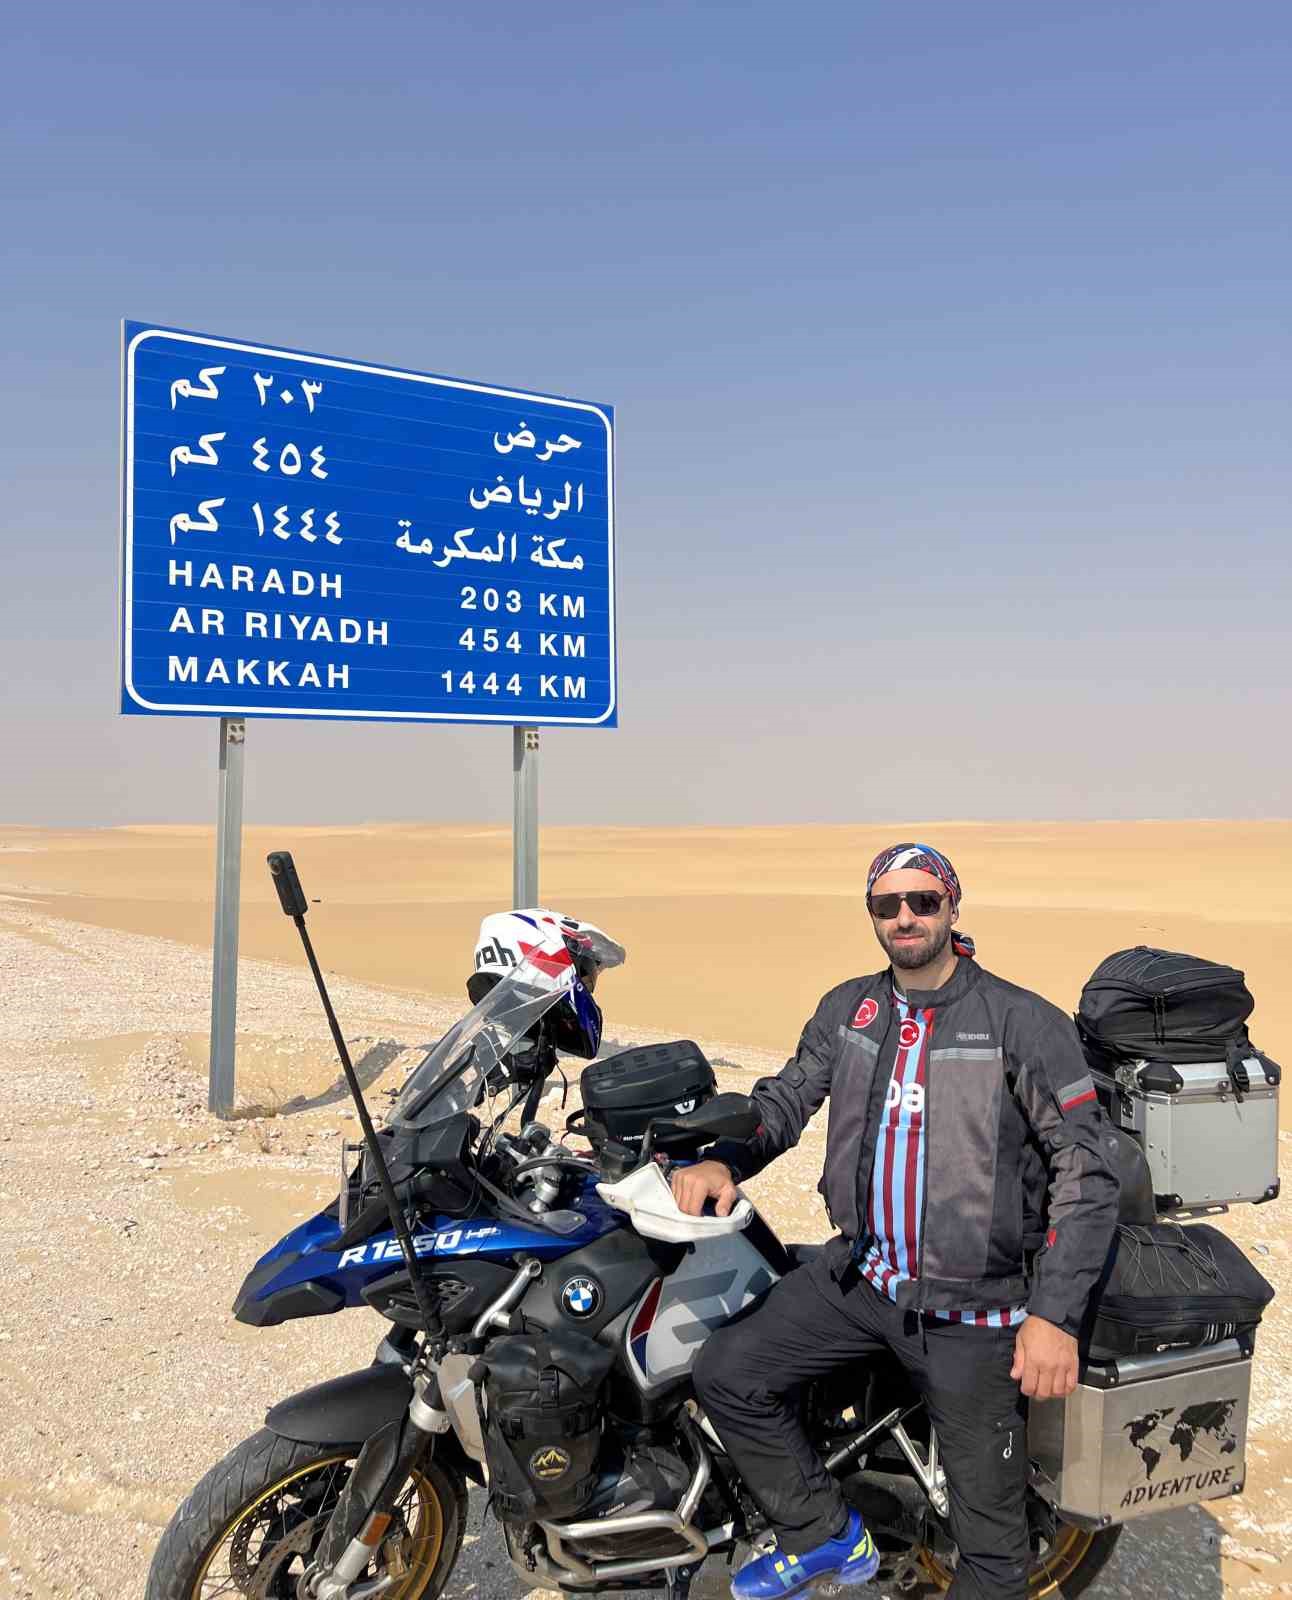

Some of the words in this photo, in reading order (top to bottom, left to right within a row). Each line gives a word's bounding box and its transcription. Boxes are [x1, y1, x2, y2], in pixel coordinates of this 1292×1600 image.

[170, 366, 227, 410] كم
[253, 372, 323, 413] ٢٠٣
[170, 431, 226, 477] كم
[252, 437, 329, 480] ٤٥٤
[493, 421, 582, 462] حرض
[470, 475, 584, 520] الرياض
[169, 497, 226, 545] كم
[252, 502, 342, 545] ١٤٤٤
[395, 519, 518, 568] المكرمة
[530, 535, 584, 570] مكة
[168, 559, 342, 599] HARADH
[460, 586, 522, 613] 203
[539, 592, 585, 618] KM
[169, 607, 225, 636] AR
[245, 611, 388, 646] RIYADH
[458, 627, 522, 654] 454
[539, 633, 585, 658] KM
[168, 655, 349, 689] MAKKAH
[441, 670, 522, 696] 1444
[540, 674, 586, 699] KM
[1120, 1465, 1235, 1508] ADVENTURE
